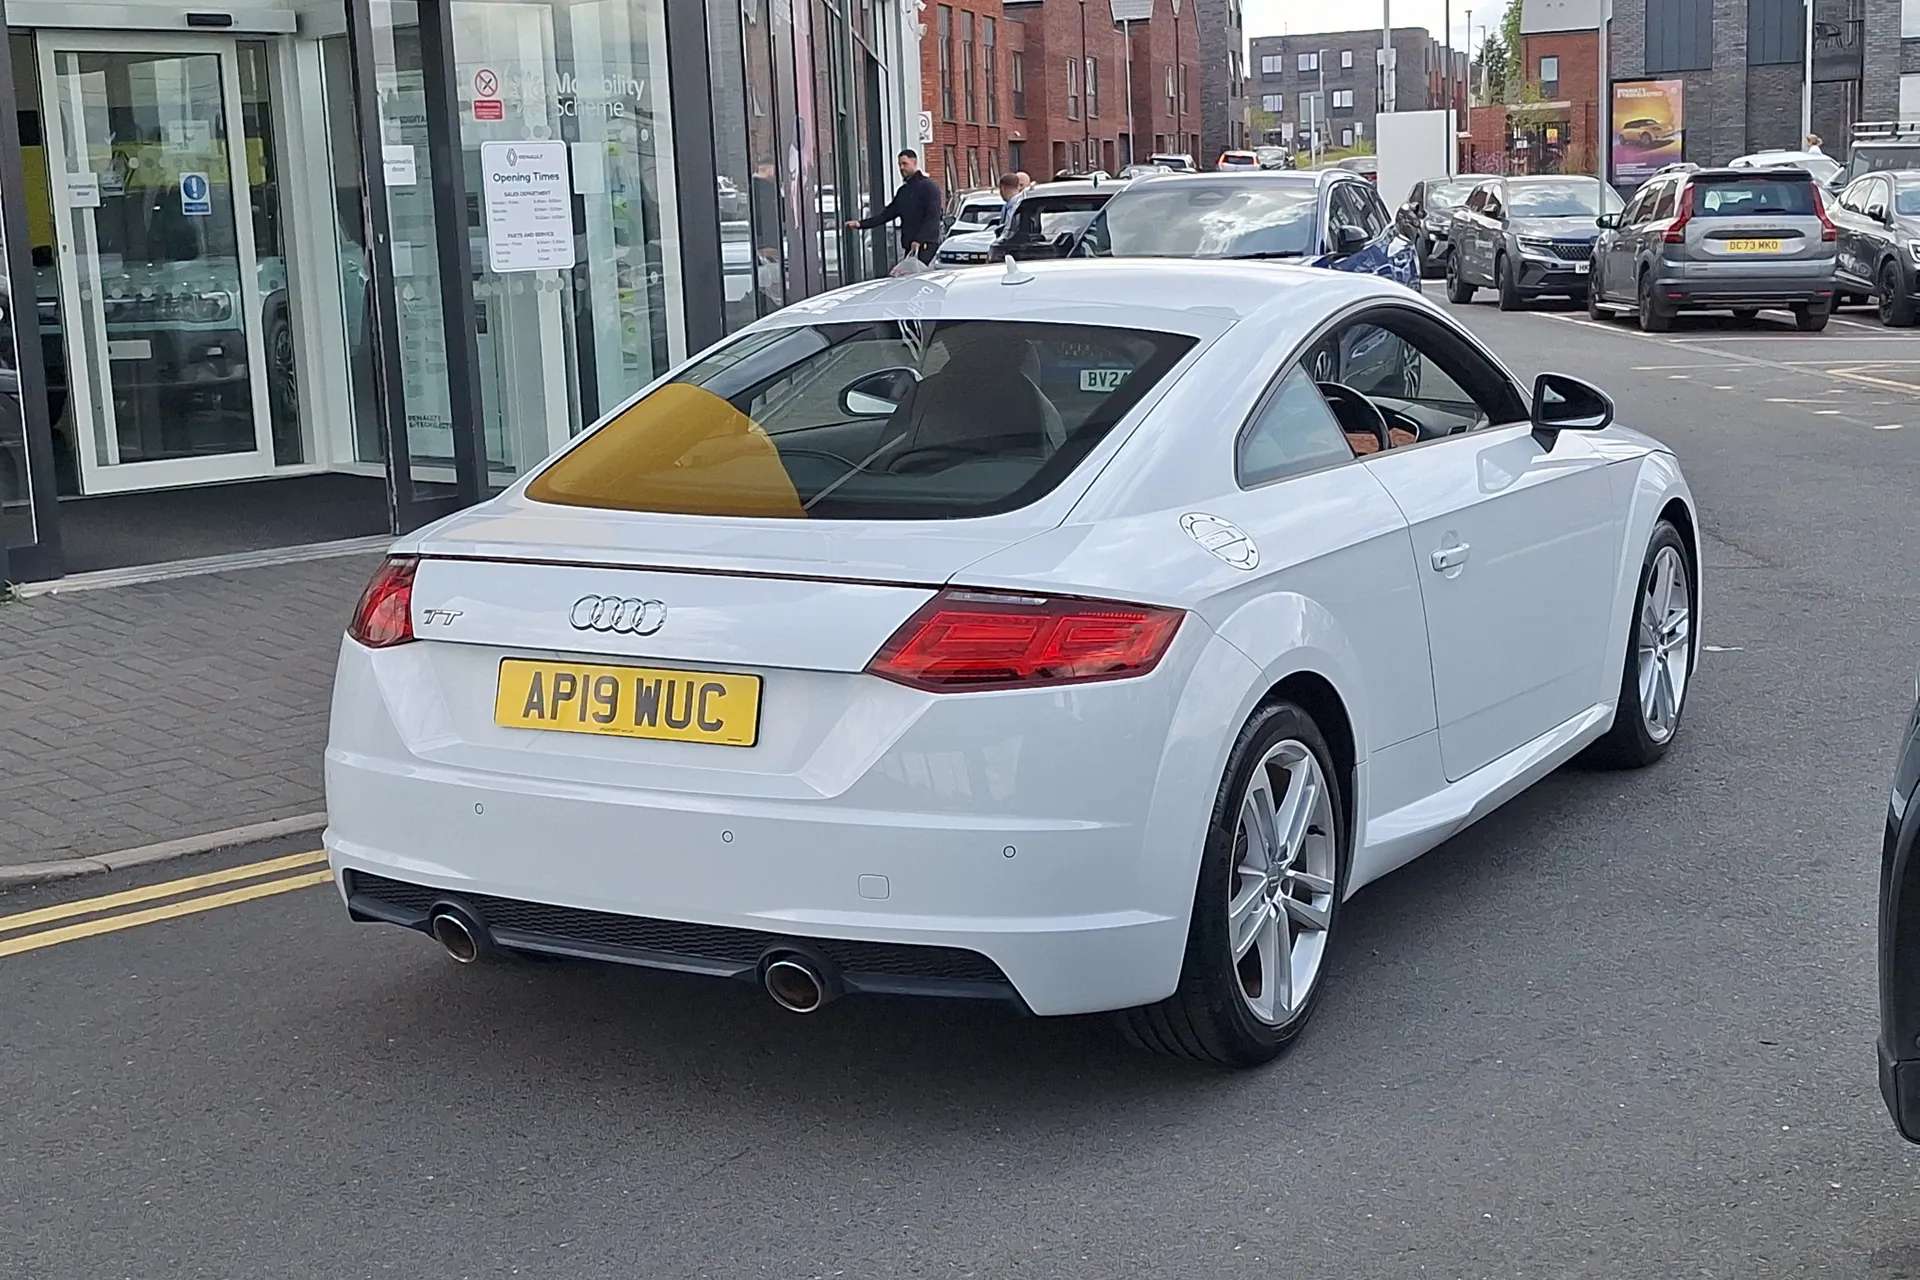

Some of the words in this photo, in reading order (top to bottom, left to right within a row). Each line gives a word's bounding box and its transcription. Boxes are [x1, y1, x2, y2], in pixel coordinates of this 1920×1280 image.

[555, 72, 644, 100] Mobility
[556, 96, 624, 117] Scheme
[493, 173, 531, 183] Opening
[533, 171, 560, 181] Times
[423, 609, 464, 626] TT
[522, 671, 620, 724] AP19
[634, 676, 728, 732] WUC
